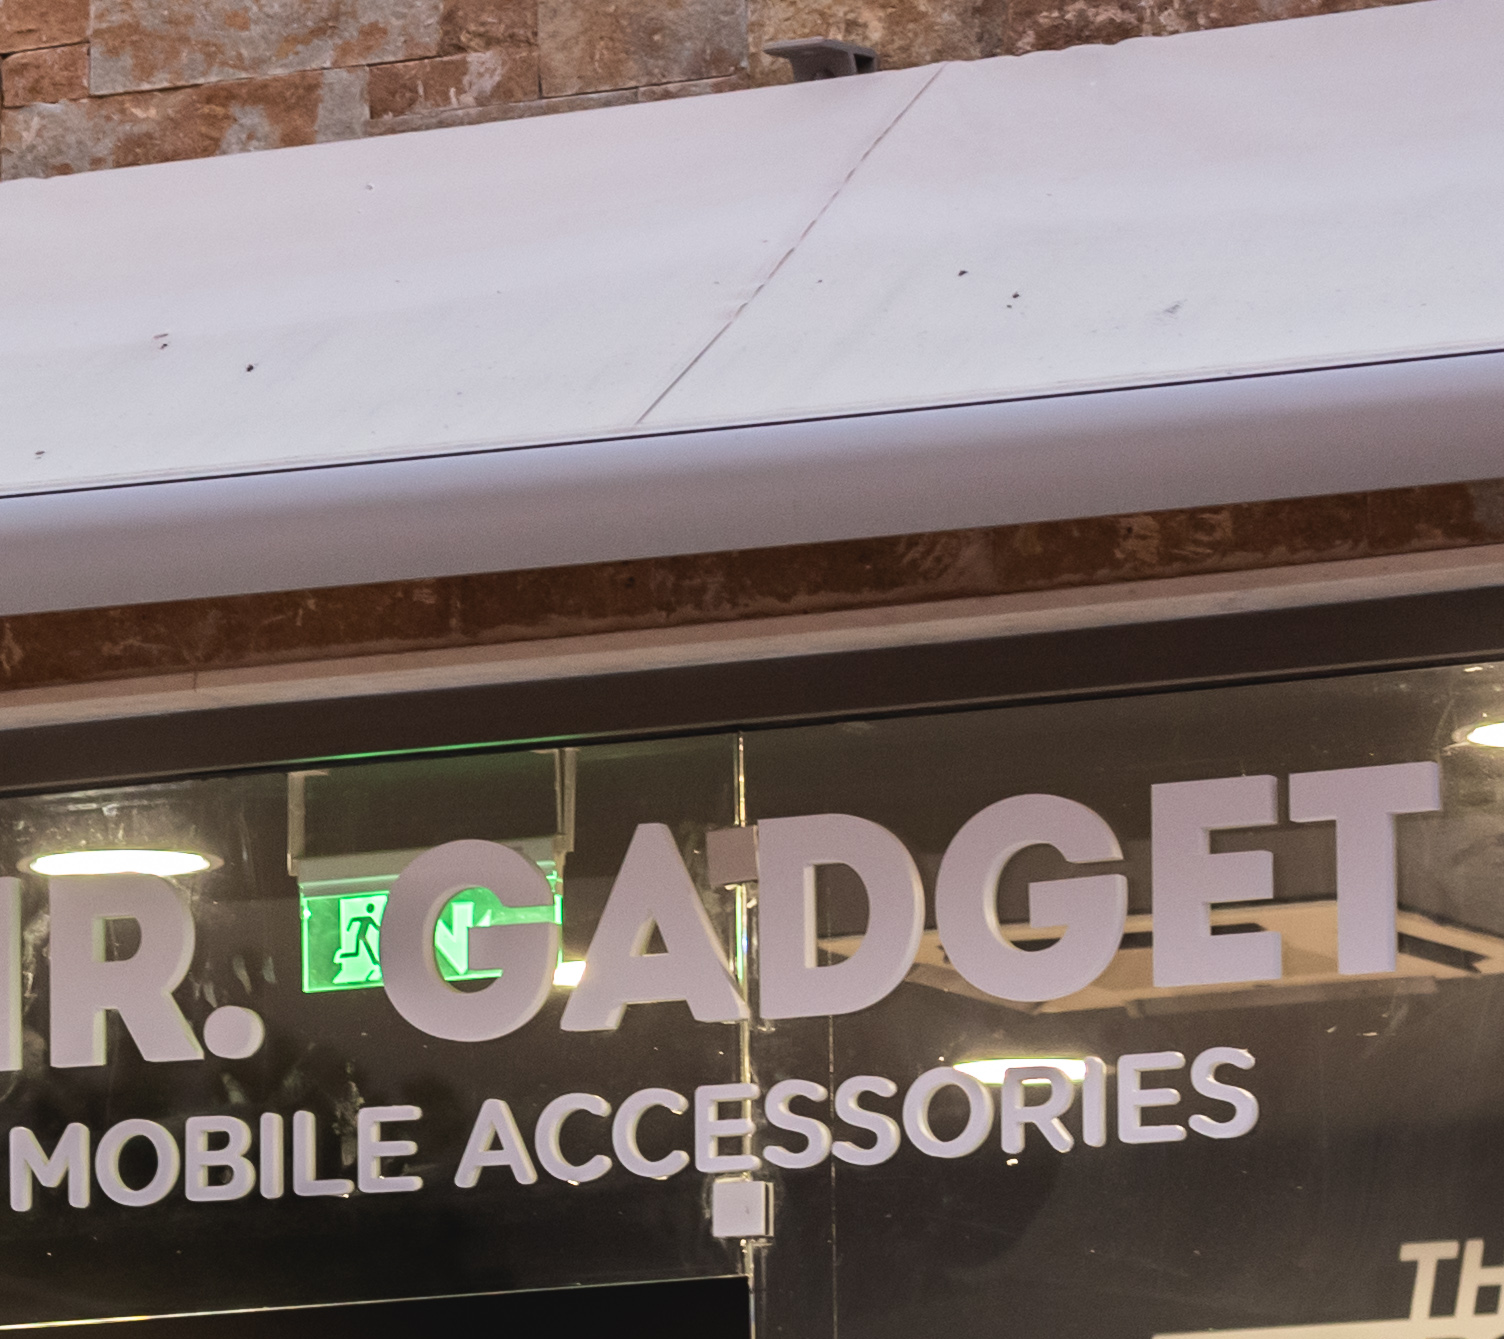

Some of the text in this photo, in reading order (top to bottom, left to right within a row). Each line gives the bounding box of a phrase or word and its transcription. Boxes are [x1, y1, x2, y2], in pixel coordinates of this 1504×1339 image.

[378, 760, 1443, 1042] GADGET
[9, 1046, 1260, 1212] MOBILE ACCESSORIES
